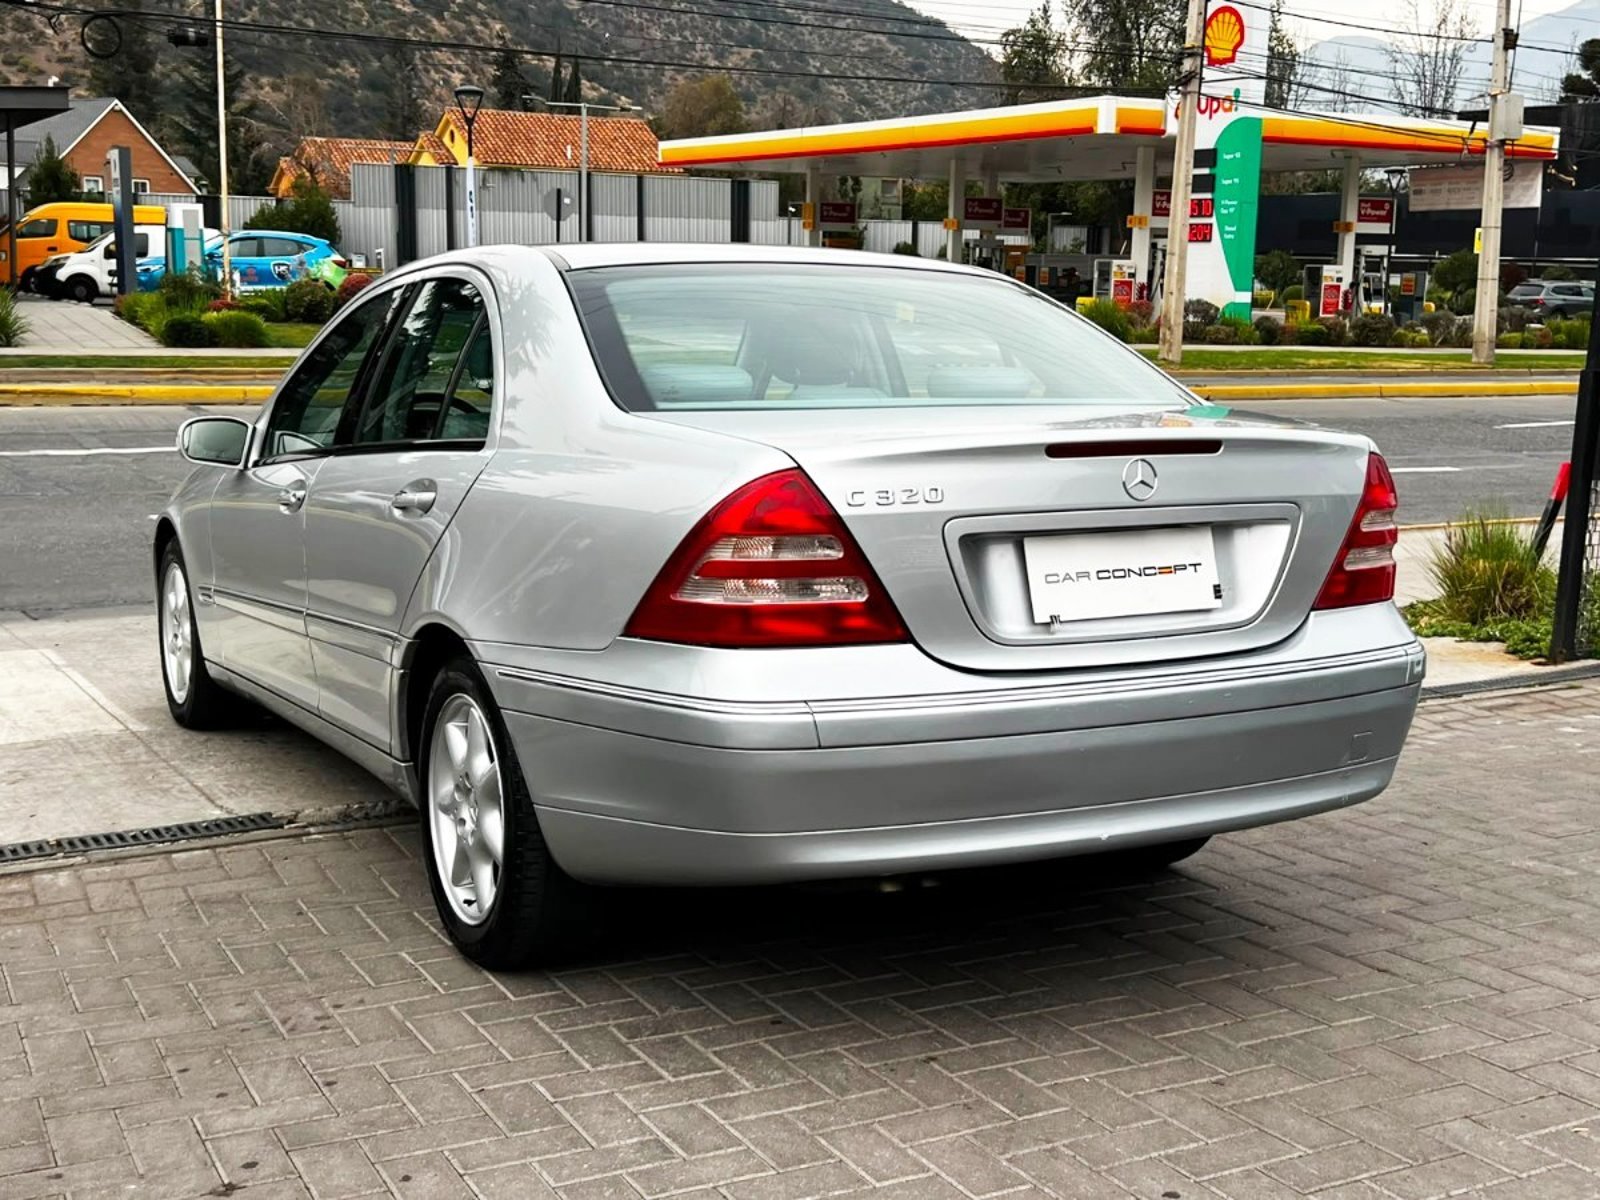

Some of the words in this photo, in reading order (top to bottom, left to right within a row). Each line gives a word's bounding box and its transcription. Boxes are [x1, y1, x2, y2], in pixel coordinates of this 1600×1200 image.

[846, 489, 866, 507] C
[875, 486, 944, 506] 320
[1045, 571, 1092, 584] CAR
[1096, 562, 1202, 581] CONCEPT
